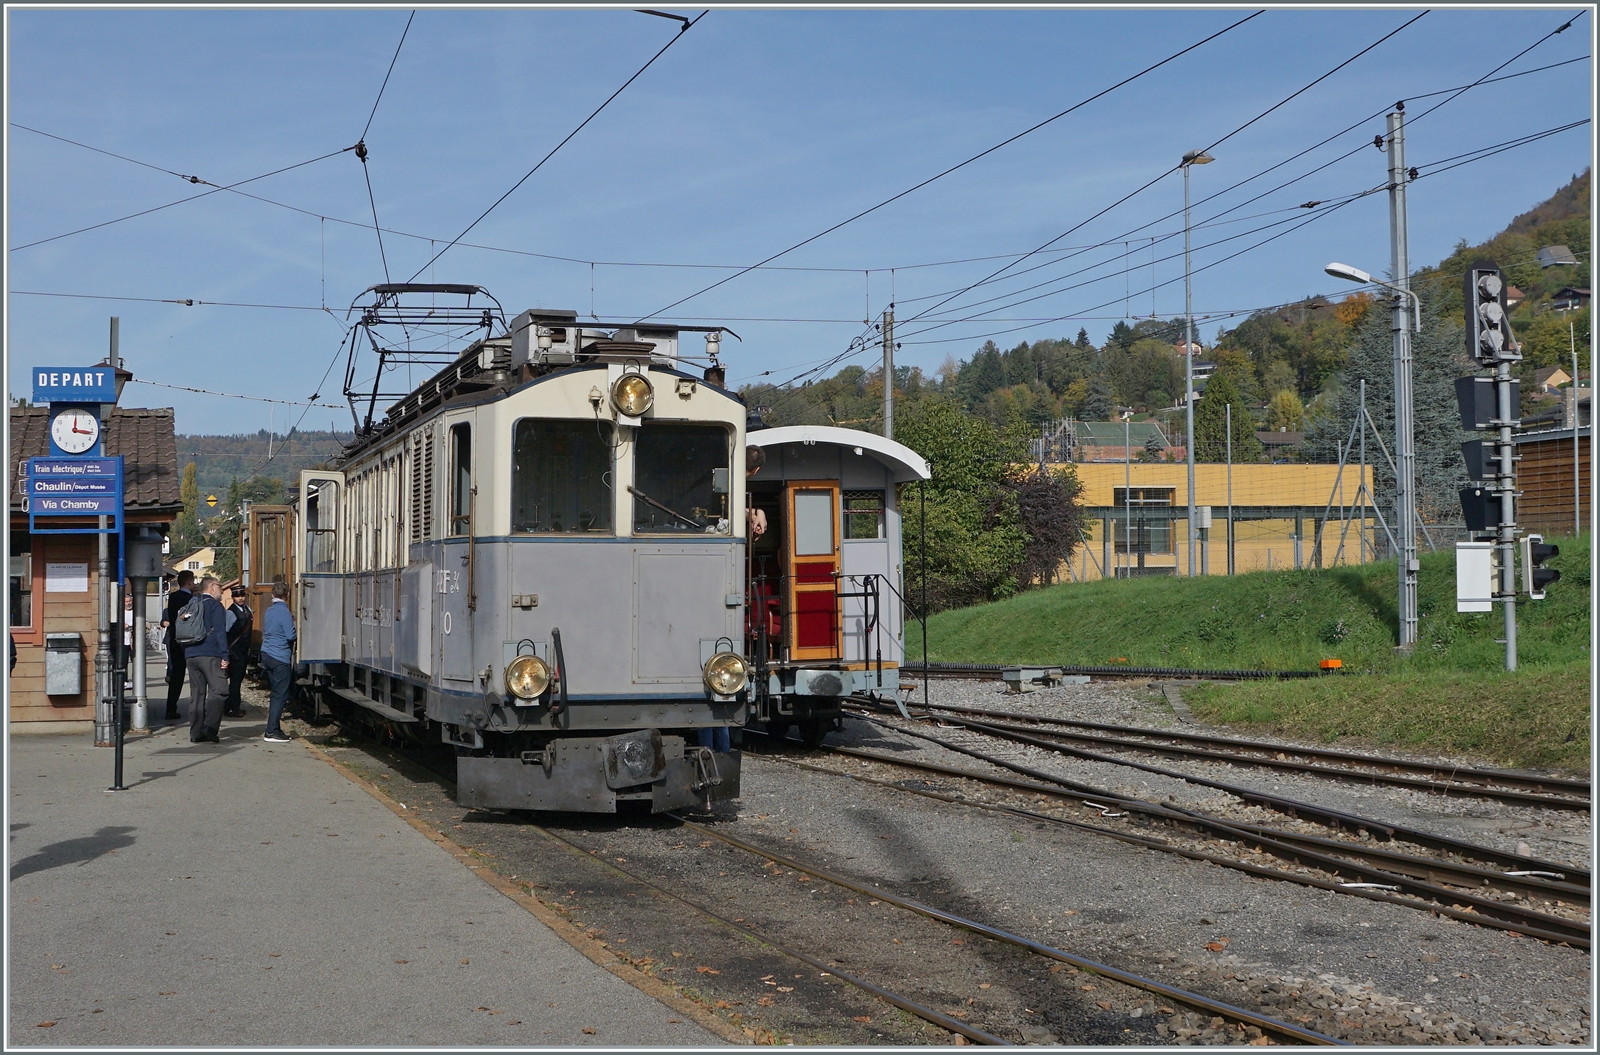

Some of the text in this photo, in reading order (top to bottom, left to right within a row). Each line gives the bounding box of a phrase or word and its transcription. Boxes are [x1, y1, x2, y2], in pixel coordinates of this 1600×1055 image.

[38, 372, 104, 387] DEPART
[34, 464, 51, 473] Train
[42, 500, 100, 510] Via Chamby
